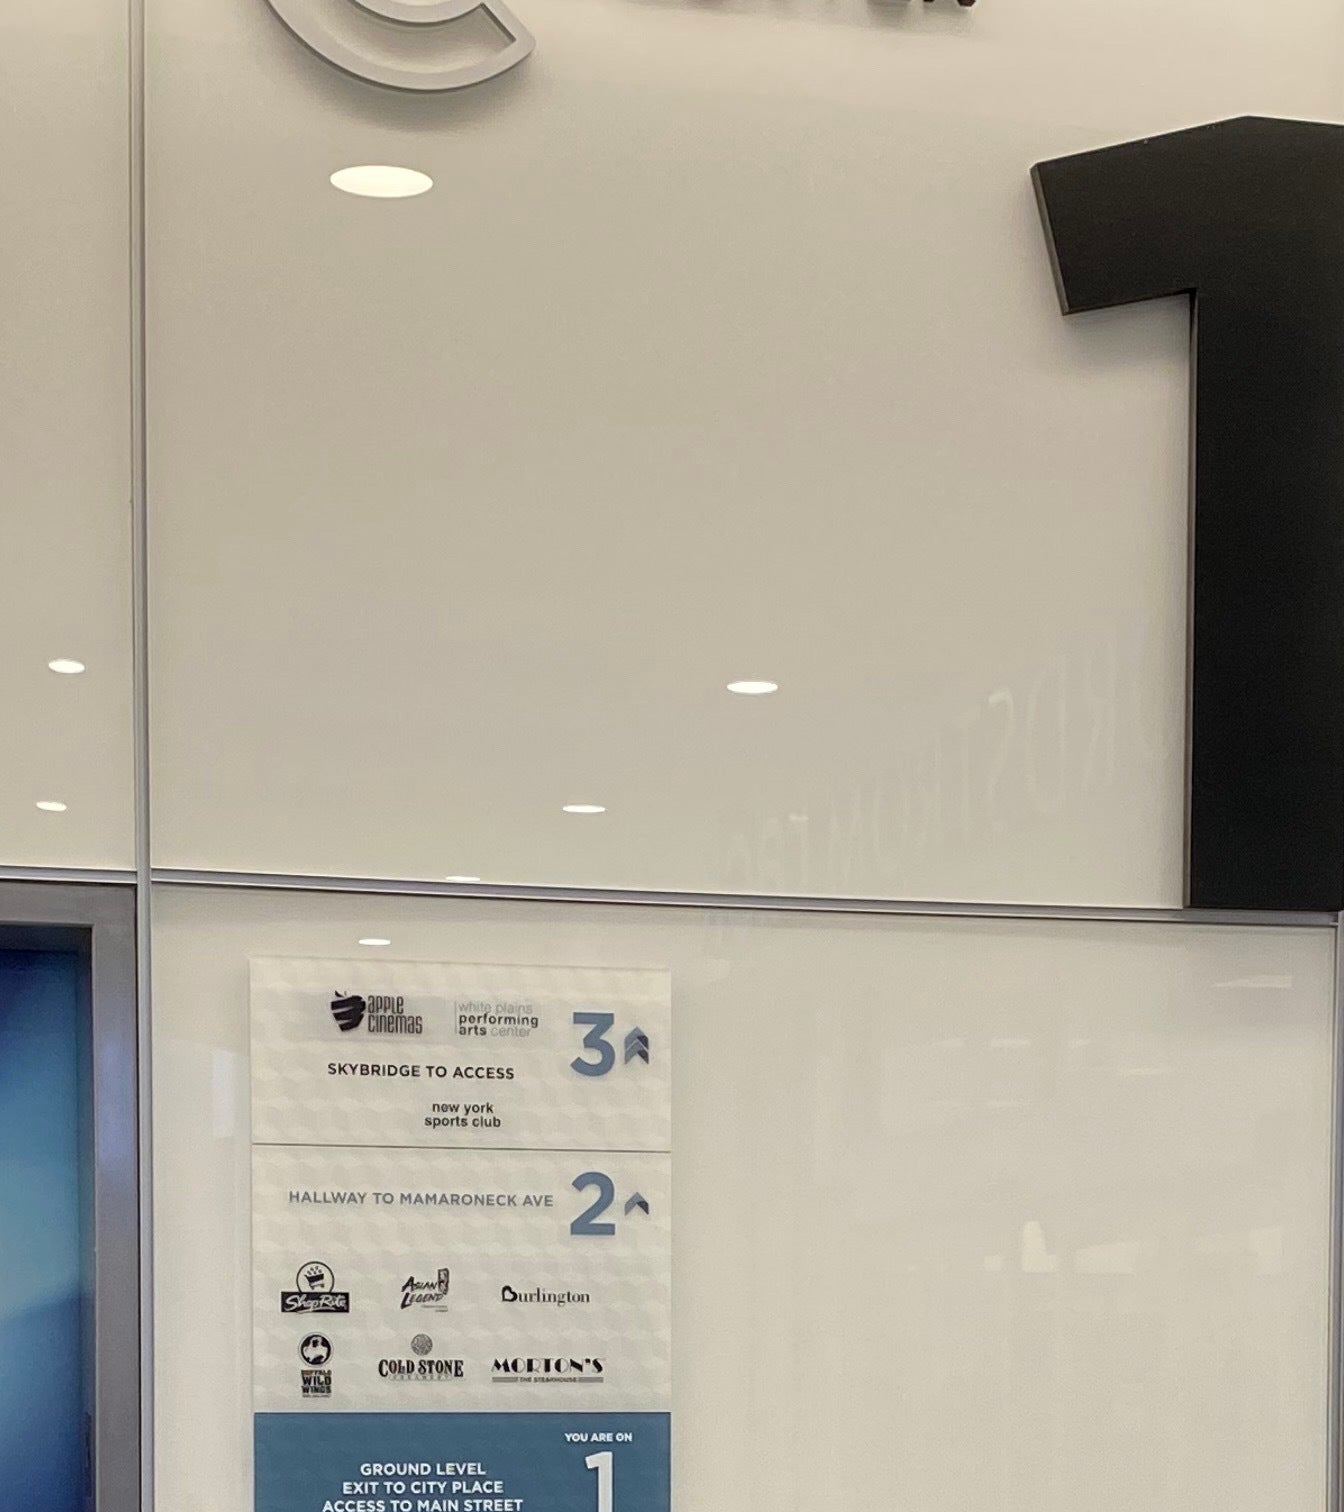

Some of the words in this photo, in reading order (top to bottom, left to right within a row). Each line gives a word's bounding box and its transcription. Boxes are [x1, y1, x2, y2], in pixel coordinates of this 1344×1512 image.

[458, 1001, 492, 1013] white
[495, 1002, 534, 1017] plains
[367, 1014, 423, 1035] cinemas
[458, 1012, 540, 1029] performing
[458, 1024, 488, 1037] arts
[490, 1025, 531, 1038] center
[570, 1012, 616, 1078] 3
[327, 1062, 422, 1078] SKYBRIDGE
[425, 1065, 448, 1079] TO
[452, 1066, 516, 1080] ACCESS
[432, 1103, 459, 1114] new
[463, 1102, 494, 1116] york
[424, 1116, 468, 1130] sports
[471, 1116, 502, 1129] club
[288, 1190, 367, 1206] HALLWAY
[373, 1191, 395, 1206] TO
[399, 1192, 518, 1208] MAMARONECK
[521, 1193, 554, 1208] AVE
[570, 1171, 616, 1237] 2
[501, 1285, 591, 1308] Burlington
[378, 1359, 416, 1377] COLD
[418, 1359, 464, 1378] STONE
[491, 1357, 605, 1374] MORTON'S
[302, 1376, 333, 1386] WILD
[301, 1385, 333, 1394] WINGS
[564, 1432, 589, 1443] YOU
[590, 1432, 614, 1442] ARE
[615, 1432, 634, 1442] ON
[359, 1462, 432, 1477] GROUND
[435, 1462, 487, 1477] LEVEL
[342, 1481, 381, 1496] EXIT
[383, 1481, 406, 1495] TO
[409, 1480, 448, 1495] CITY
[451, 1480, 505, 1495] PLACE
[416, 1499, 460, 1512] MAIN
[463, 1498, 524, 1512] STREET
